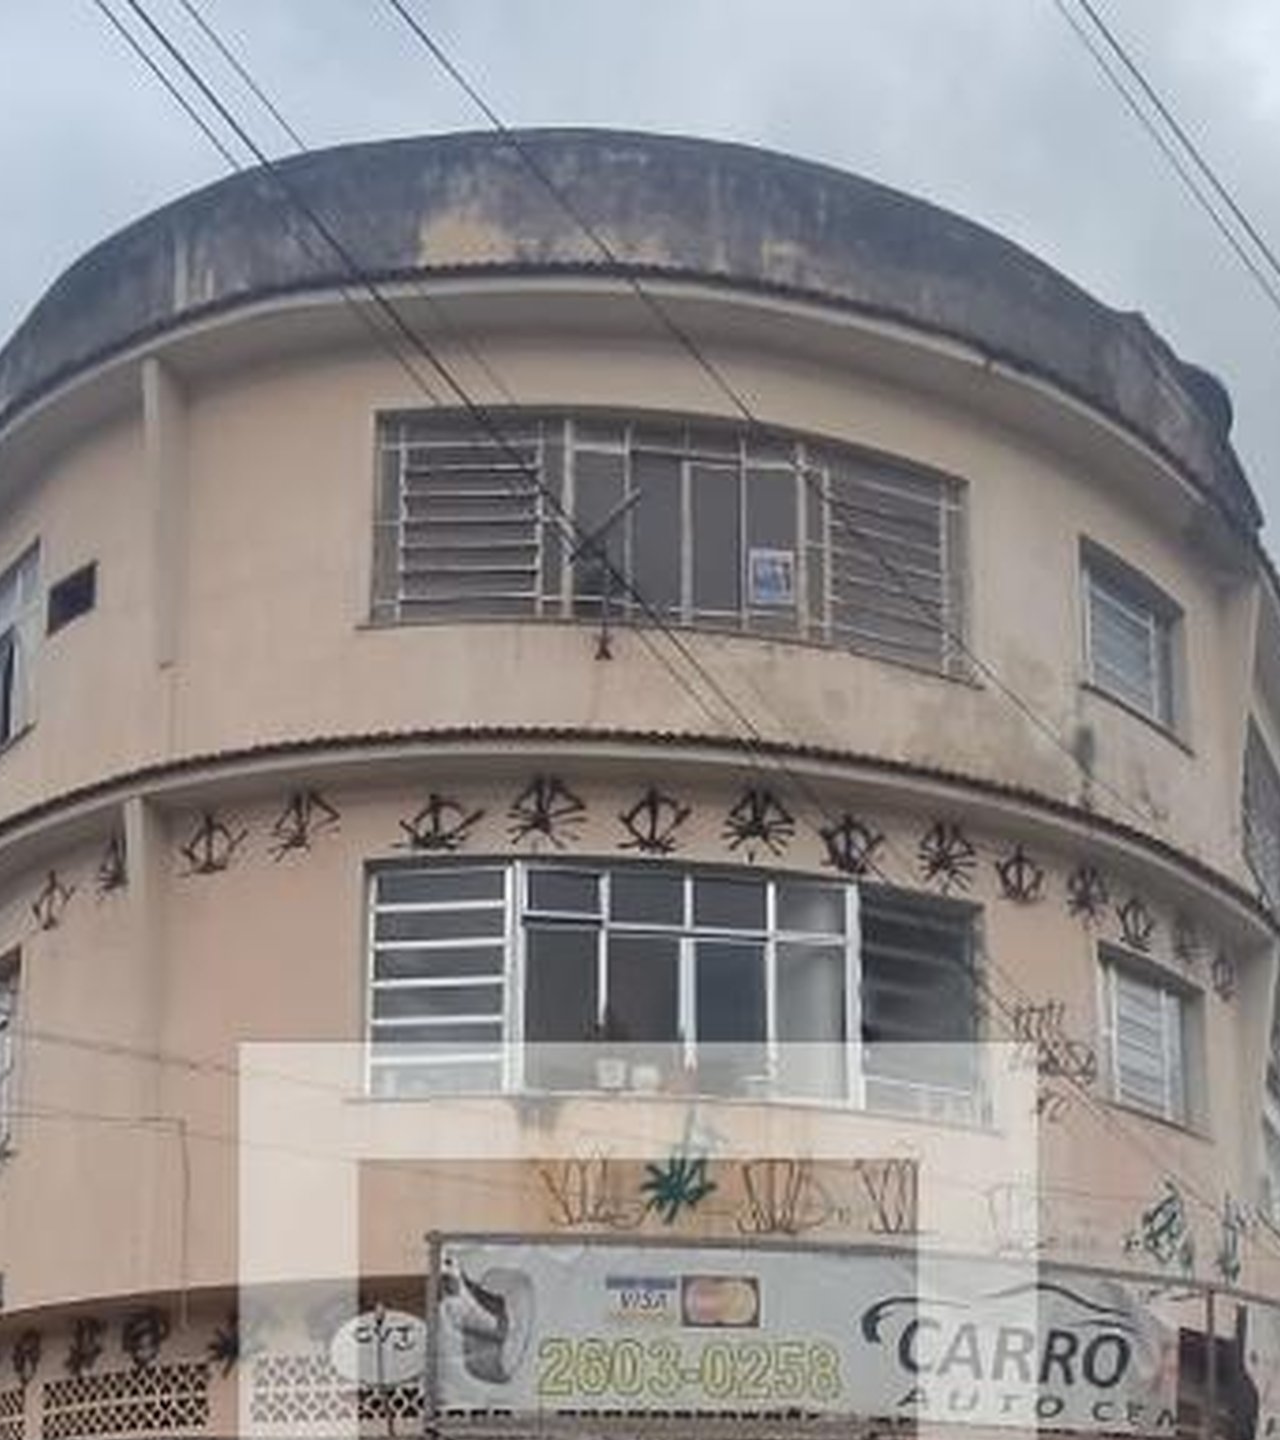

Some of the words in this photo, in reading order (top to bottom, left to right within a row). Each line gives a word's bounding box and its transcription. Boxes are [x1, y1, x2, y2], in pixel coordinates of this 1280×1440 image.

[538, 1337, 841, 1399] 2603-0258
[897, 1318, 1132, 1389] CARRO
[896, 1386, 1065, 1419] AUTO
